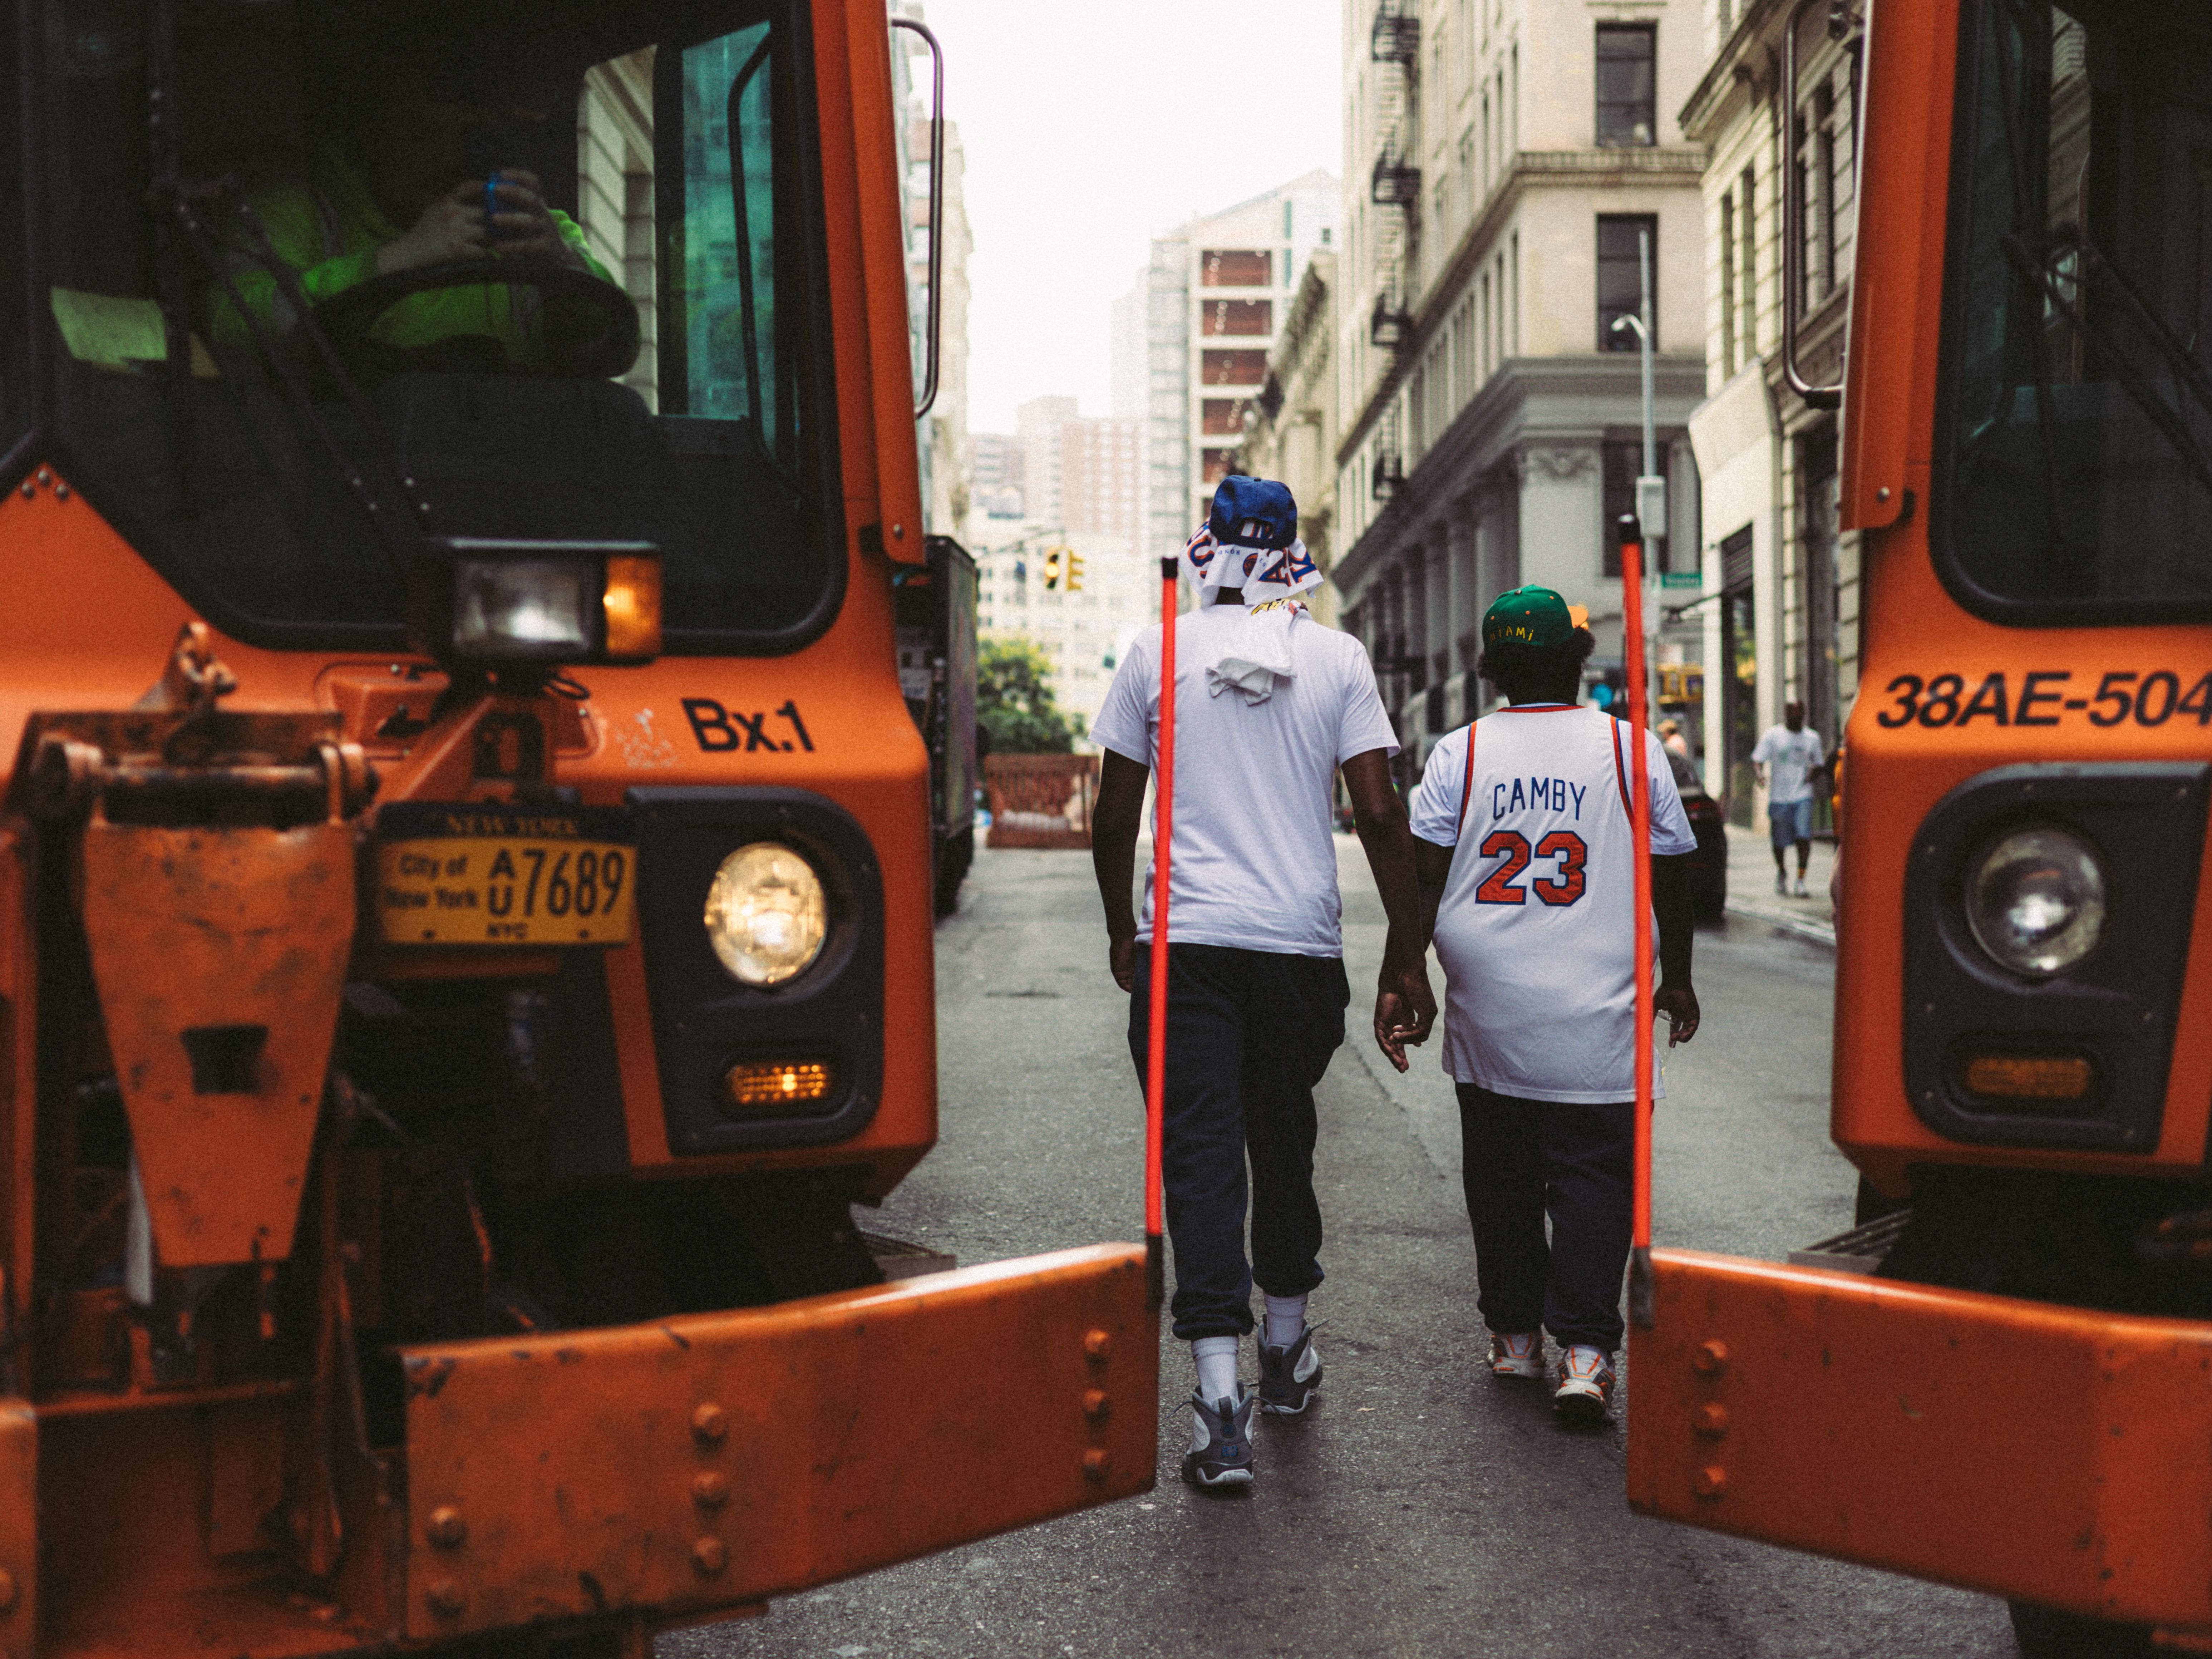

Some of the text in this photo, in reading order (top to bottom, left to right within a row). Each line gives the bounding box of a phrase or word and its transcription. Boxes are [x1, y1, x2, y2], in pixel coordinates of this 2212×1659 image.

[1877, 671, 2212, 729] 38AE-504
[681, 698, 815, 752] Bx.1
[1493, 777, 1586, 821] CAMBY
[399, 853, 468, 880] City of
[1475, 830, 1588, 907] 23
[384, 887, 478, 909] New York
